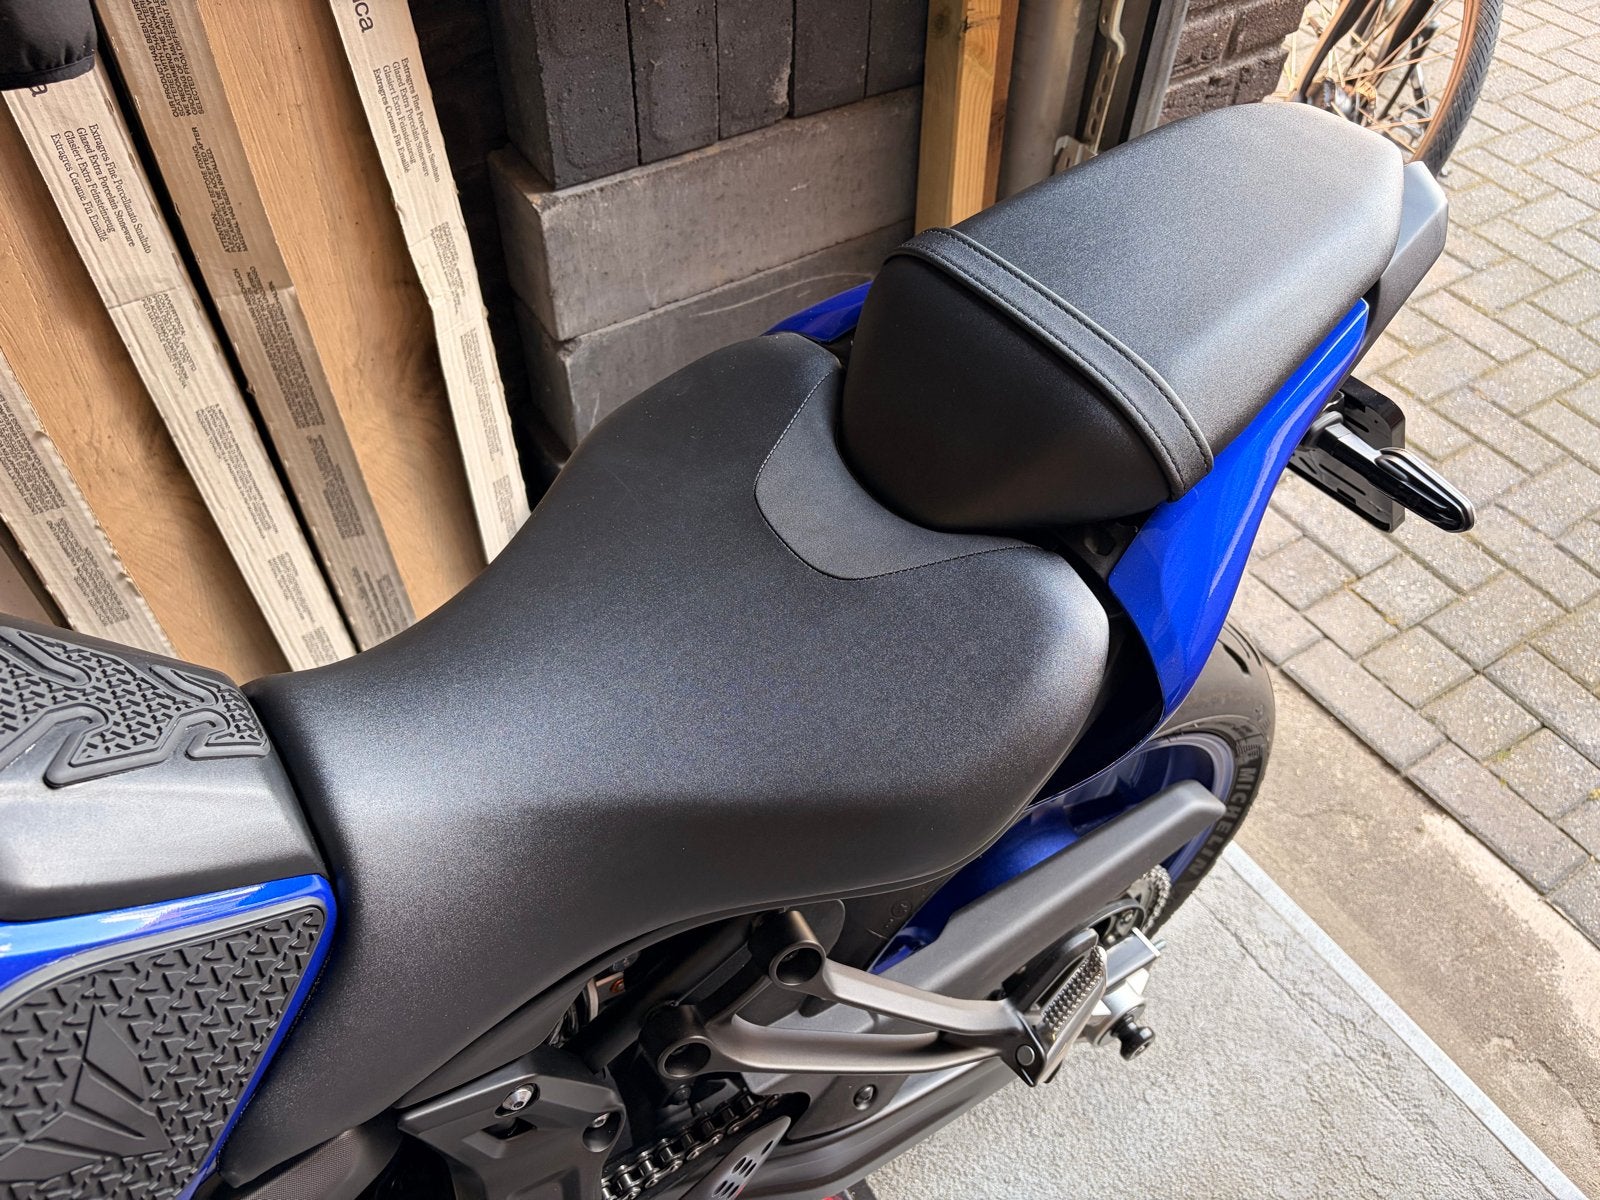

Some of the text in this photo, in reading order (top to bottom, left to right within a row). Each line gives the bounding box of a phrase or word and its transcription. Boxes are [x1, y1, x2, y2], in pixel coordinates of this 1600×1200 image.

[140, 22, 153, 43] BEEN
[149, 8, 163, 34] LAYING
[159, 17, 172, 40] USING
[163, 8, 183, 50] DIFFERENT
[352, 0, 373, 33] ca
[148, 46, 159, 61] HAS
[158, 53, 170, 71] WITH
[159, 37, 169, 50] THE
[168, 43, 177, 55] MM
[155, 63, 173, 99] PRODUCT
[165, 53, 187, 101] RECOMMEND
[176, 65, 184, 74] OF
[178, 53, 191, 73] FROM
[400, 57, 418, 95] Extragres
[166, 74, 186, 116] SCATTERED
[180, 76, 198, 114] GROUTING
[187, 76, 205, 114] SELECTED
[372, 68, 391, 106] Extragres
[384, 105, 399, 134] Cerame
[393, 134, 403, 147] Fin
[382, 64, 397, 96] Glasiert
[391, 95, 404, 117] Extra
[411, 94, 422, 112] Fine
[169, 102, 180, 117] OUR
[184, 105, 192, 115] WE
[391, 61, 431, 177] Glazed Extra Porcelain Stoneware
[191, 128, 205, 150] AFTER
[415, 111, 435, 154] Porcellanato
[50, 132, 75, 173] Extragres
[68, 171, 89, 202] Cerame
[82, 200, 95, 215] Fin
[63, 130, 117, 234] Glasiert Extra Feinsteinzeug
[76, 126, 137, 248] Glazed Extra Porcelain Stoneware
[88, 122, 154, 255] Extragres Fine Porcellanato Smaltato
[1187, 767, 1256, 876] MICHELIN
